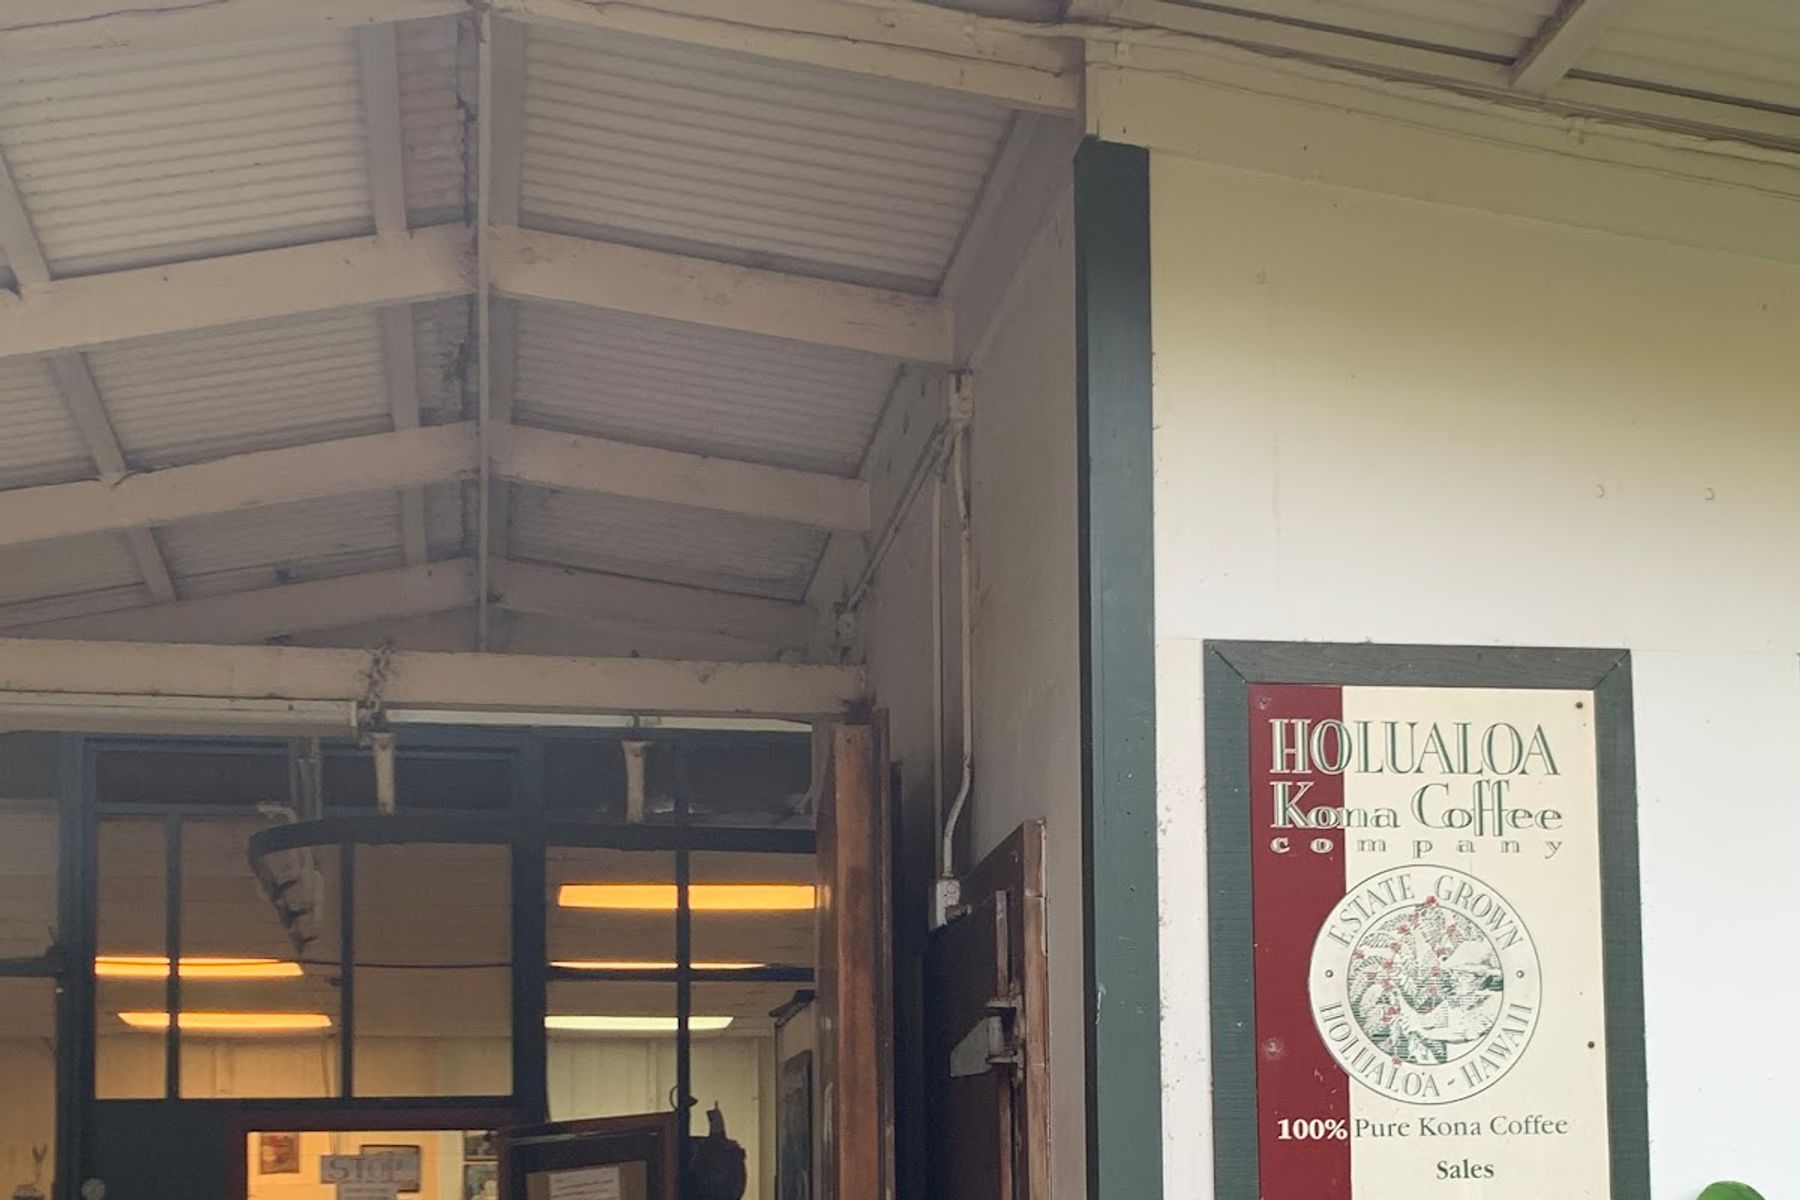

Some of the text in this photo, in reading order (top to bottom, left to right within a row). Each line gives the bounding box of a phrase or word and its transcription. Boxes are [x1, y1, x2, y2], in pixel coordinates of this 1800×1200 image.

[1268, 718, 1561, 776] HOLUALOA
[1269, 780, 1562, 837] Kona Coffee
[1270, 837, 1562, 859] company
[1327, 874, 1523, 951] ESTATE GROWN
[1319, 1001, 1440, 1097] HOLUALOA
[1460, 1003, 1532, 1088] HAWAII
[1277, 1115, 1569, 1140] 100% Pure Kona Coffee
[328, 1157, 401, 1181] STOP
[1436, 1160, 1494, 1179] Sales
